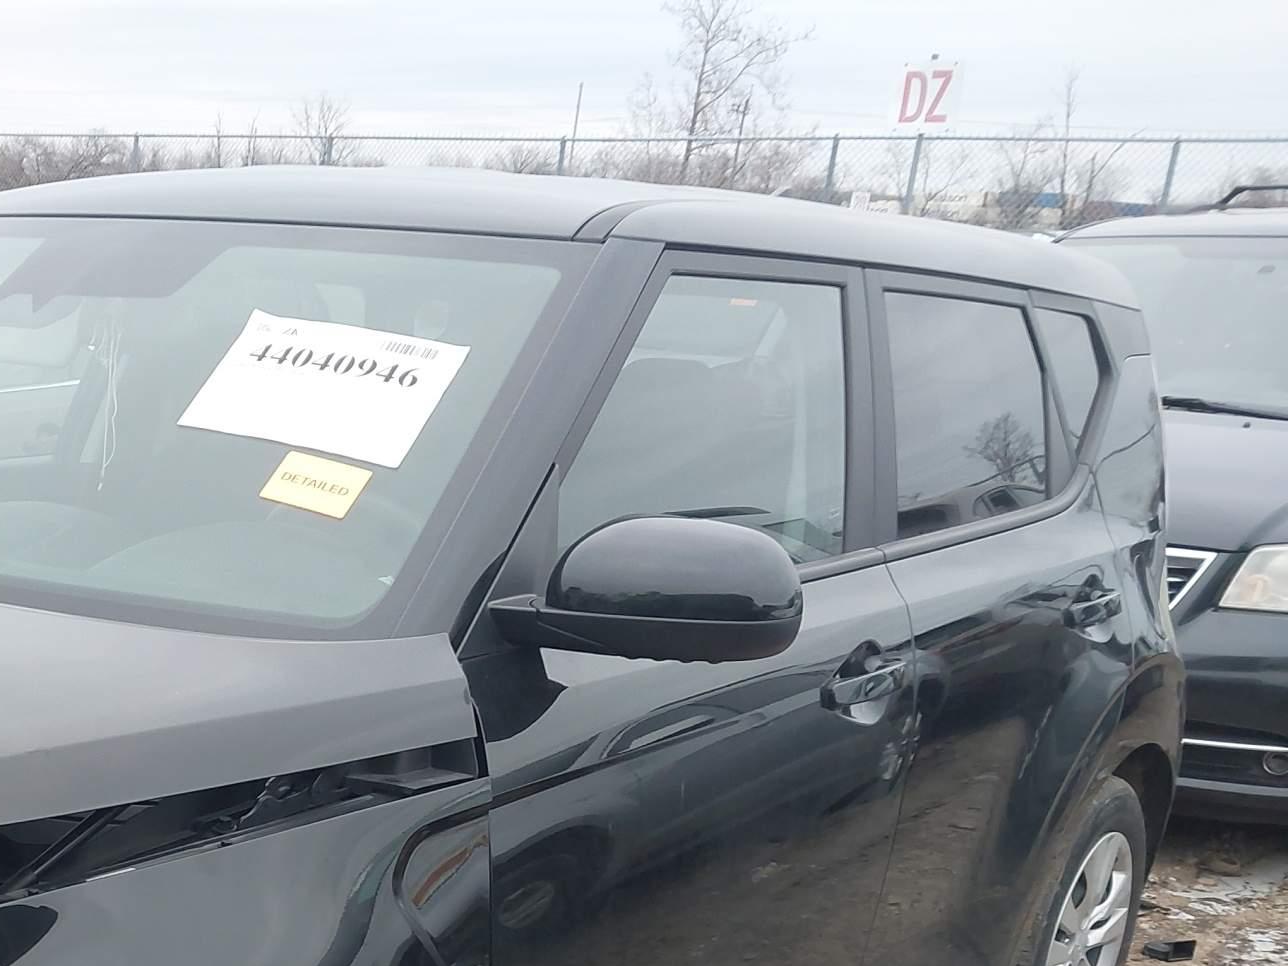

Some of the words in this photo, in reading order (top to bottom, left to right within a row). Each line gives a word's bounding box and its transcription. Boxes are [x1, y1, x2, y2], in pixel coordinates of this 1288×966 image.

[897, 69, 954, 124] DZ
[248, 343, 420, 388] 44040946
[280, 470, 350, 498] DETAILED
